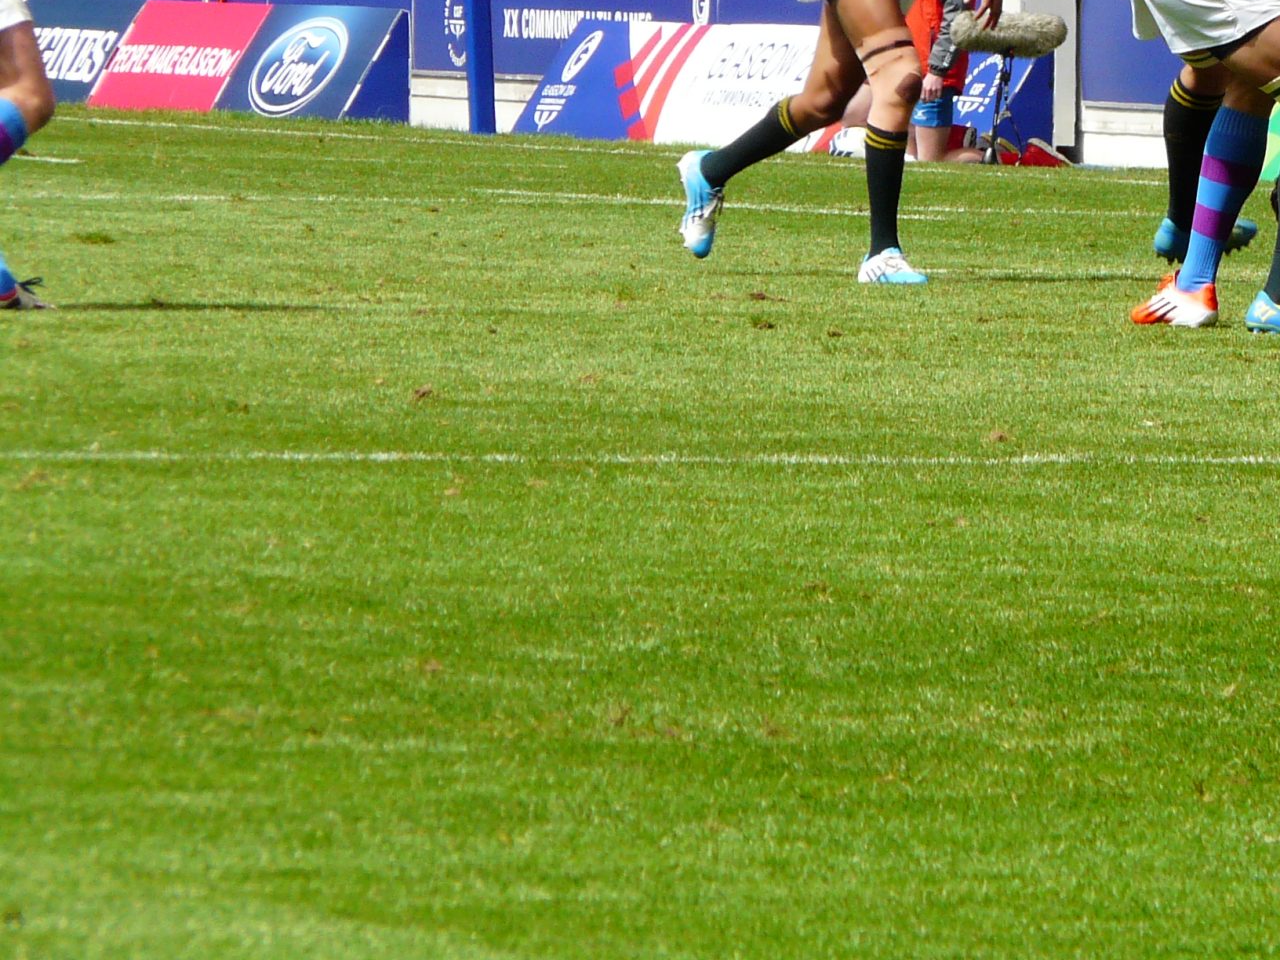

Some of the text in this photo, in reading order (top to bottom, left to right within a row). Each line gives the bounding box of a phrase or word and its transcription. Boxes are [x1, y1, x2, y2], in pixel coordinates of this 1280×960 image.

[503, 8, 519, 38] XX
[173, 46, 240, 77] GLASGOW
[261, 31, 330, 96] Ford
